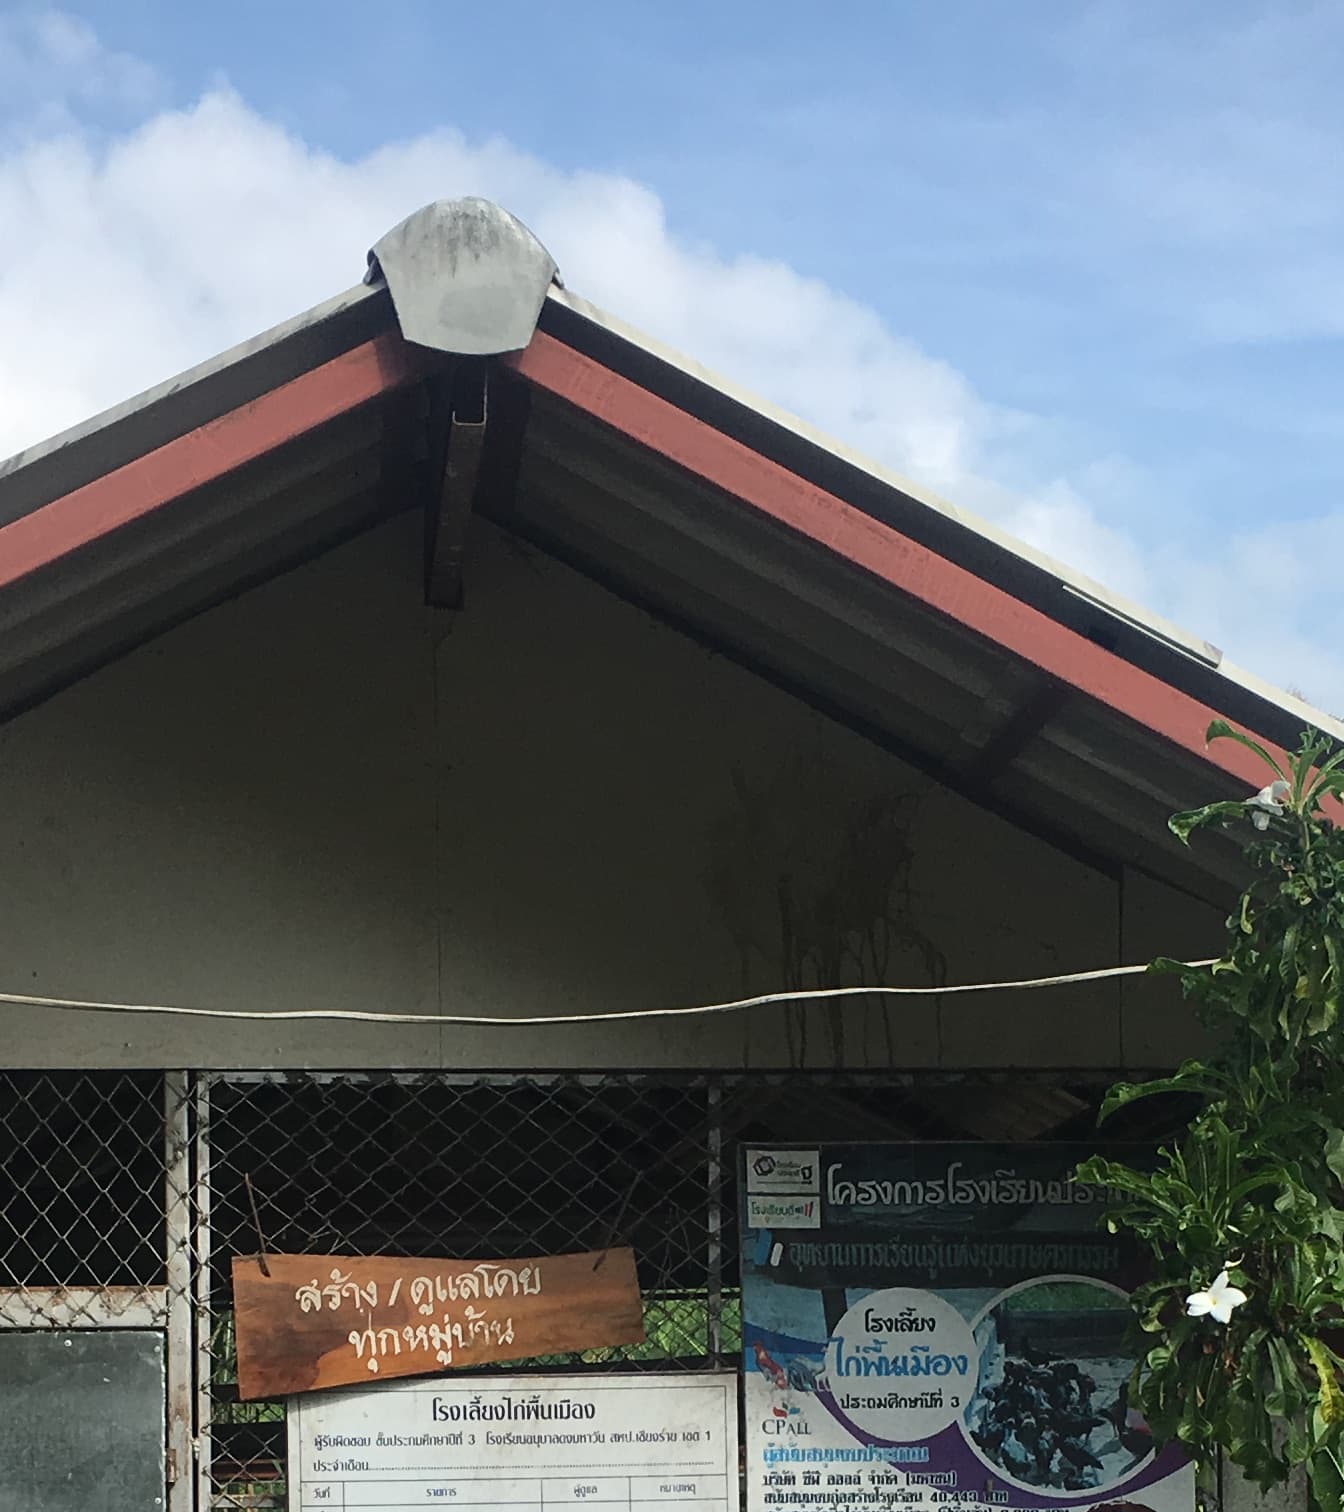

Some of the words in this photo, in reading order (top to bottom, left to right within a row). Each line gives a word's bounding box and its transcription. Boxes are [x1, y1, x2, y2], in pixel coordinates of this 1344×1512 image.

[295, 1267, 378, 1313] สร้าง
[387, 1278, 402, 1308] /
[410, 1262, 543, 1316] ดูแลโดย
[864, 1307, 937, 1333] โรงเลี้ยง
[347, 1305, 517, 1374] ทุกหมู่บ้าน
[827, 1335, 969, 1378] ไก่พื้นเมือง
[432, 1394, 596, 1422] โรงเลี้ยงไก่พื้นเมือง
[840, 1388, 944, 1410] ประถมศึกษาปีที่
[950, 1396, 960, 1409] 3
[313, 1433, 371, 1452] ผู้รับผิดชอบ
[375, 1431, 463, 1448] ชั้นประถมศึกษาปีที่
[468, 1434, 476, 1446] 3
[486, 1430, 605, 1449] โรงเรียนอนุบาลดงมหาวัน
[610, 1430, 677, 1444] สพป.เชียงราย
[682, 1430, 700, 1442] เขต
[705, 1430, 711, 1441] 1
[868, 1470, 897, 1485] จำกัด
[313, 1487, 331, 1499] วันที่
[426, 1487, 457, 1498] รายการ
[573, 1484, 598, 1498] ผู้ดูแล
[659, 1484, 696, 1496] หมายเหตุ
